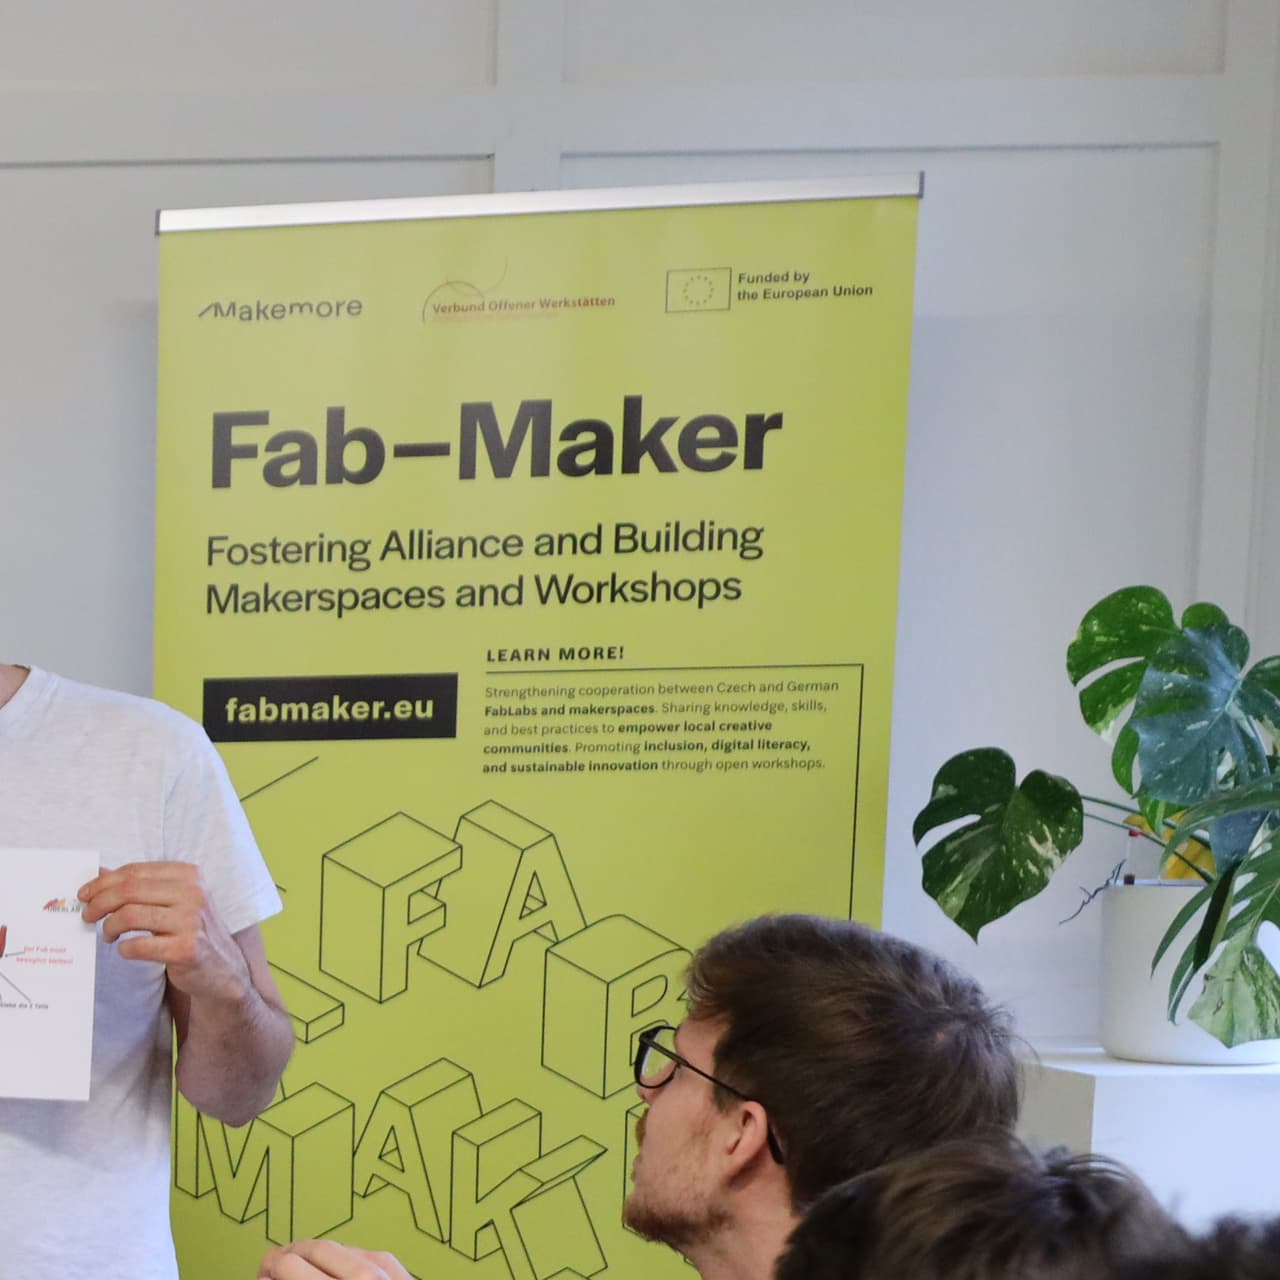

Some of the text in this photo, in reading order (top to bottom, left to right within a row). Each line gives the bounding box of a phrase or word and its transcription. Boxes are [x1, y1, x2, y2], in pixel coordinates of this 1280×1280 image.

[739, 271, 810, 284] Funded by
[737, 285, 873, 301] the European Union
[198, 299, 363, 322] Makemore
[433, 301, 485, 314] Verbund
[207, 520, 765, 572] Fostering Alliance and Building
[206, 571, 743, 619] Makerspaces and Workshops
[486, 646, 625, 663] LEARN MORE!
[485, 681, 839, 701] Strengthening cooperation between Czech and German
[225, 695, 434, 722] fabmaker.eu
[484, 704, 537, 717] FabLabs
[541, 704, 566, 715] and
[662, 701, 711, 716] Sharing
[714, 700, 789, 715] knowledge,
[791, 700, 828, 713] skills,
[484, 720, 773, 737] and best practices to empower local creative
[575, 741, 641, 755] Promoting
[643, 740, 708, 752] inclusion,
[711, 739, 754, 753] digital
[757, 738, 811, 752] literacy,
[483, 757, 826, 773] and sustainable innovation through open workshops.
